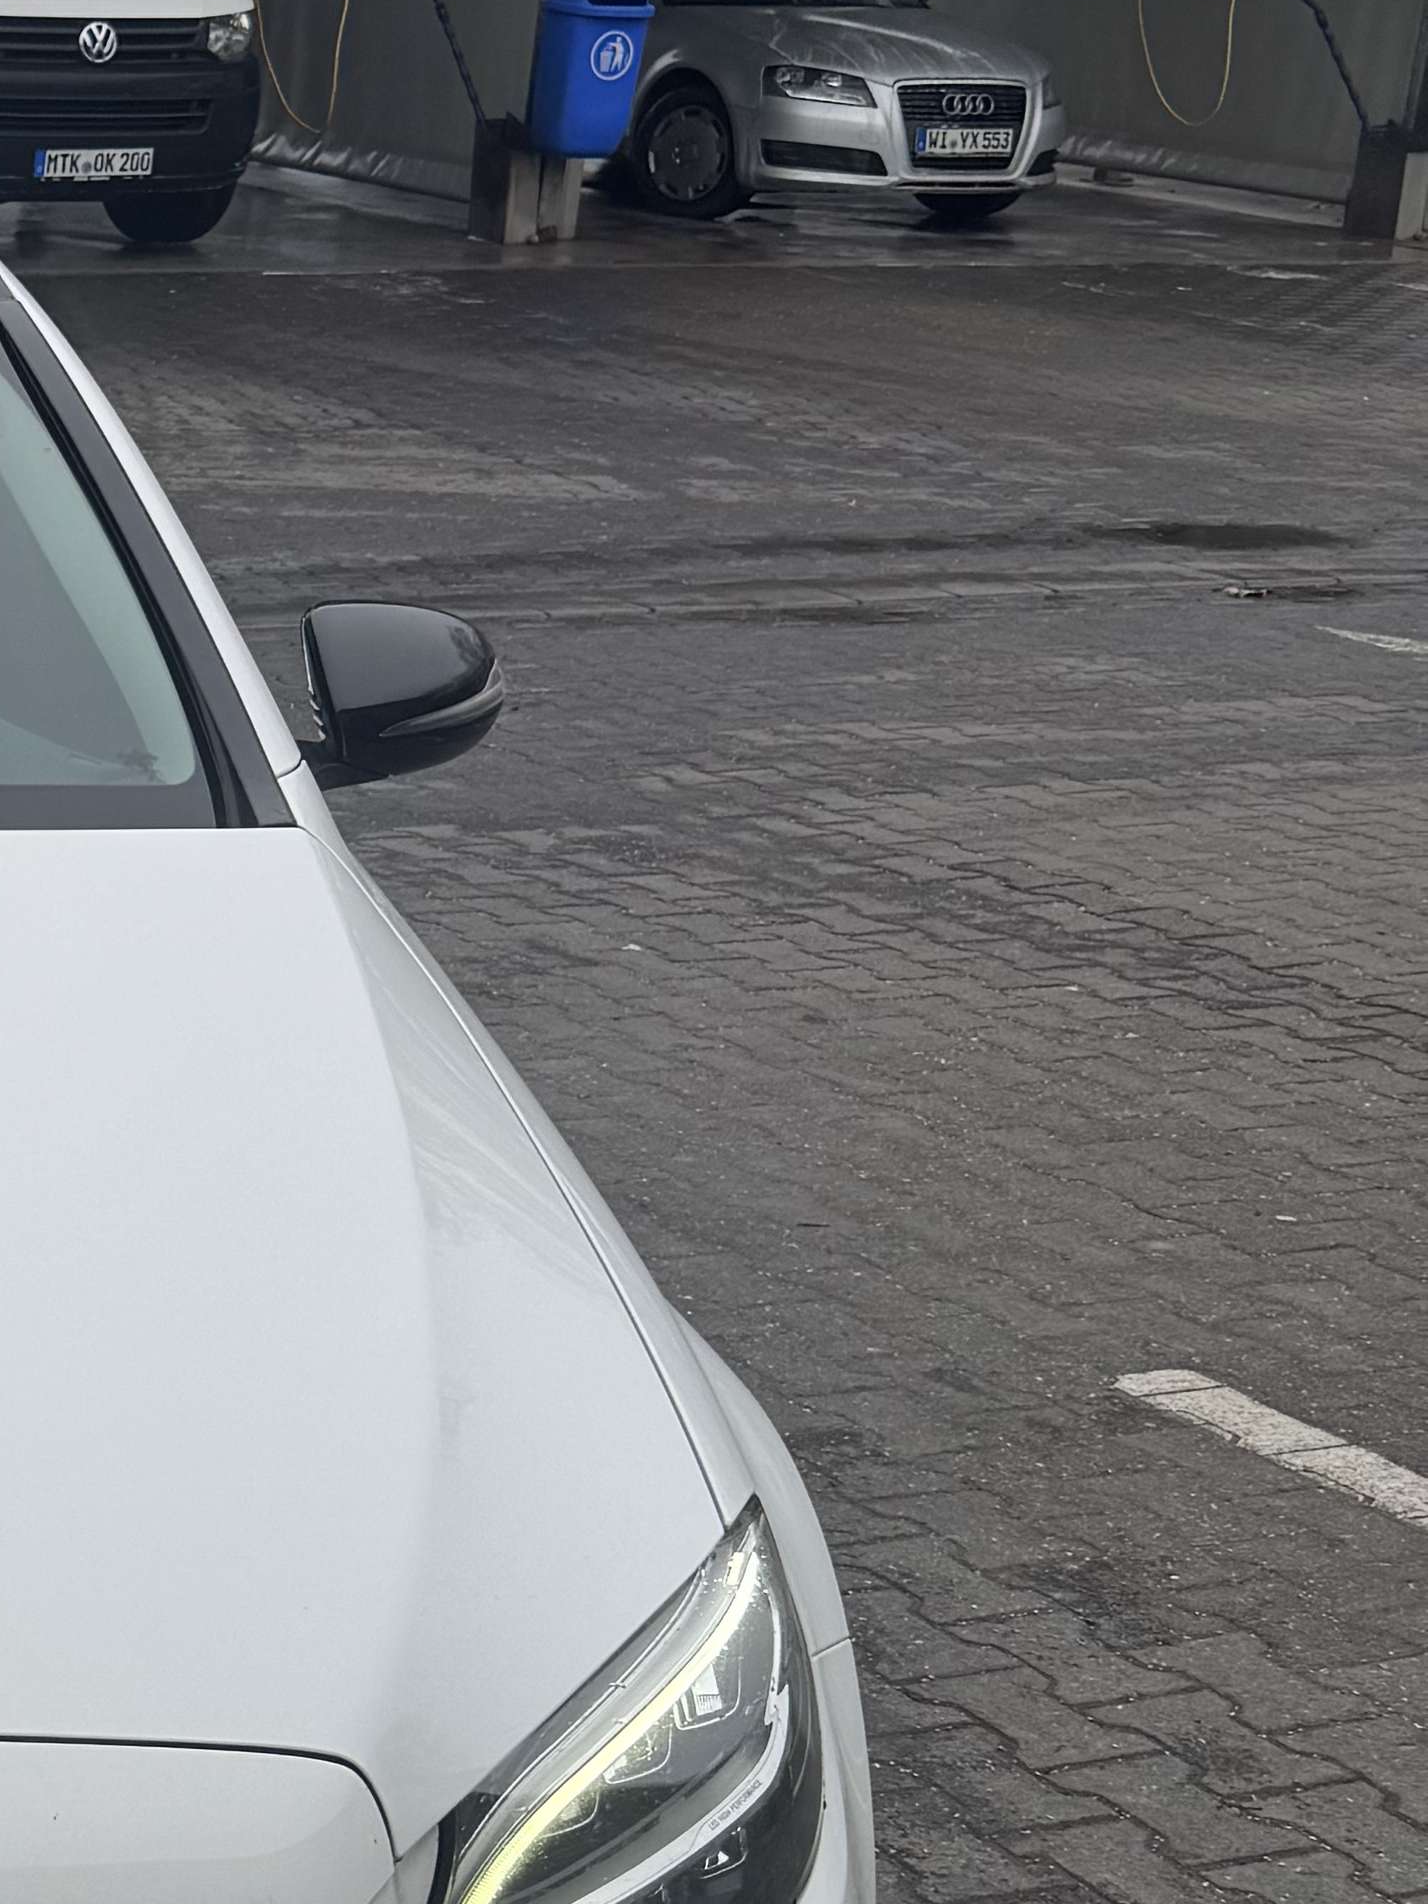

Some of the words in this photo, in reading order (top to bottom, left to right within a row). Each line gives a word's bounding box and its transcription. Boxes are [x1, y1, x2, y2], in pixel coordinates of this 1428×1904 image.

[928, 131, 947, 149] WI
[960, 132, 980, 149] YX
[982, 132, 1011, 149] 553
[46, 152, 82, 174] MTK
[93, 152, 117, 172] OK
[119, 151, 151, 172] 200
